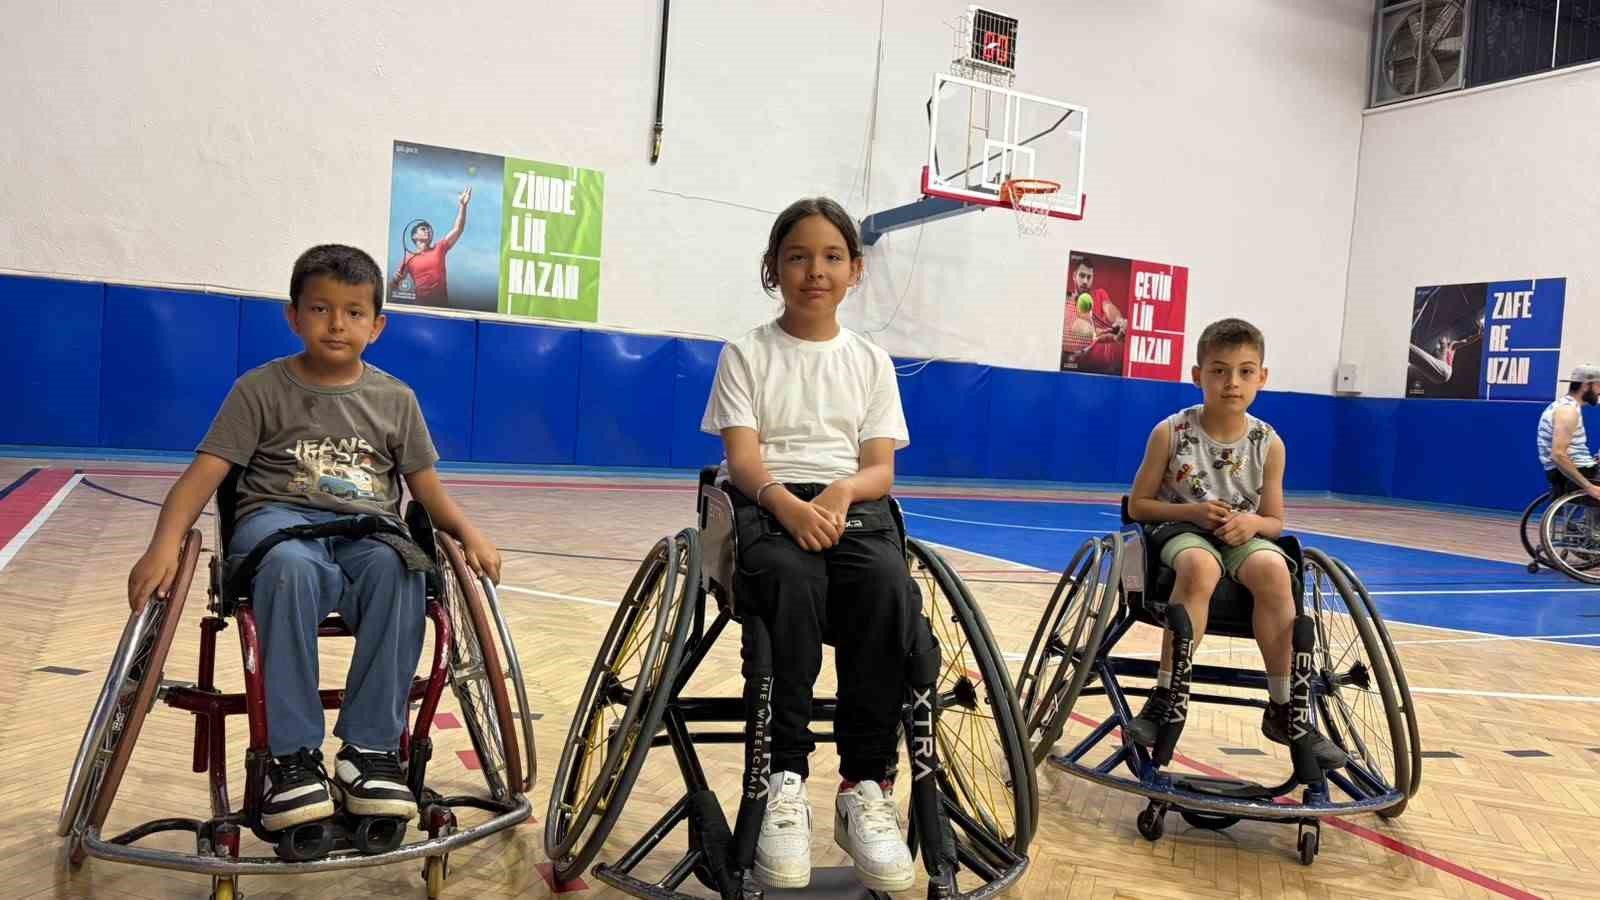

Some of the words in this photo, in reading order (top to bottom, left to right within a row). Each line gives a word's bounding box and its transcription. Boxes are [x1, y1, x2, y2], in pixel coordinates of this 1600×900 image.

[512, 170, 577, 215] ZİNDE
[508, 258, 579, 300] KAZAN
[1135, 271, 1172, 302] ÇEVİK
[1492, 291, 1534, 319] ZAFE
[1130, 335, 1172, 365] KAZAN
[1489, 325, 1511, 352] RE
[1487, 357, 1530, 384] UZAN
[285, 436, 375, 461] JEANS
[760, 675, 771, 701] THE
[1293, 652, 1311, 740] EXTRA
[747, 708, 765, 799] WHEELCHAIR
